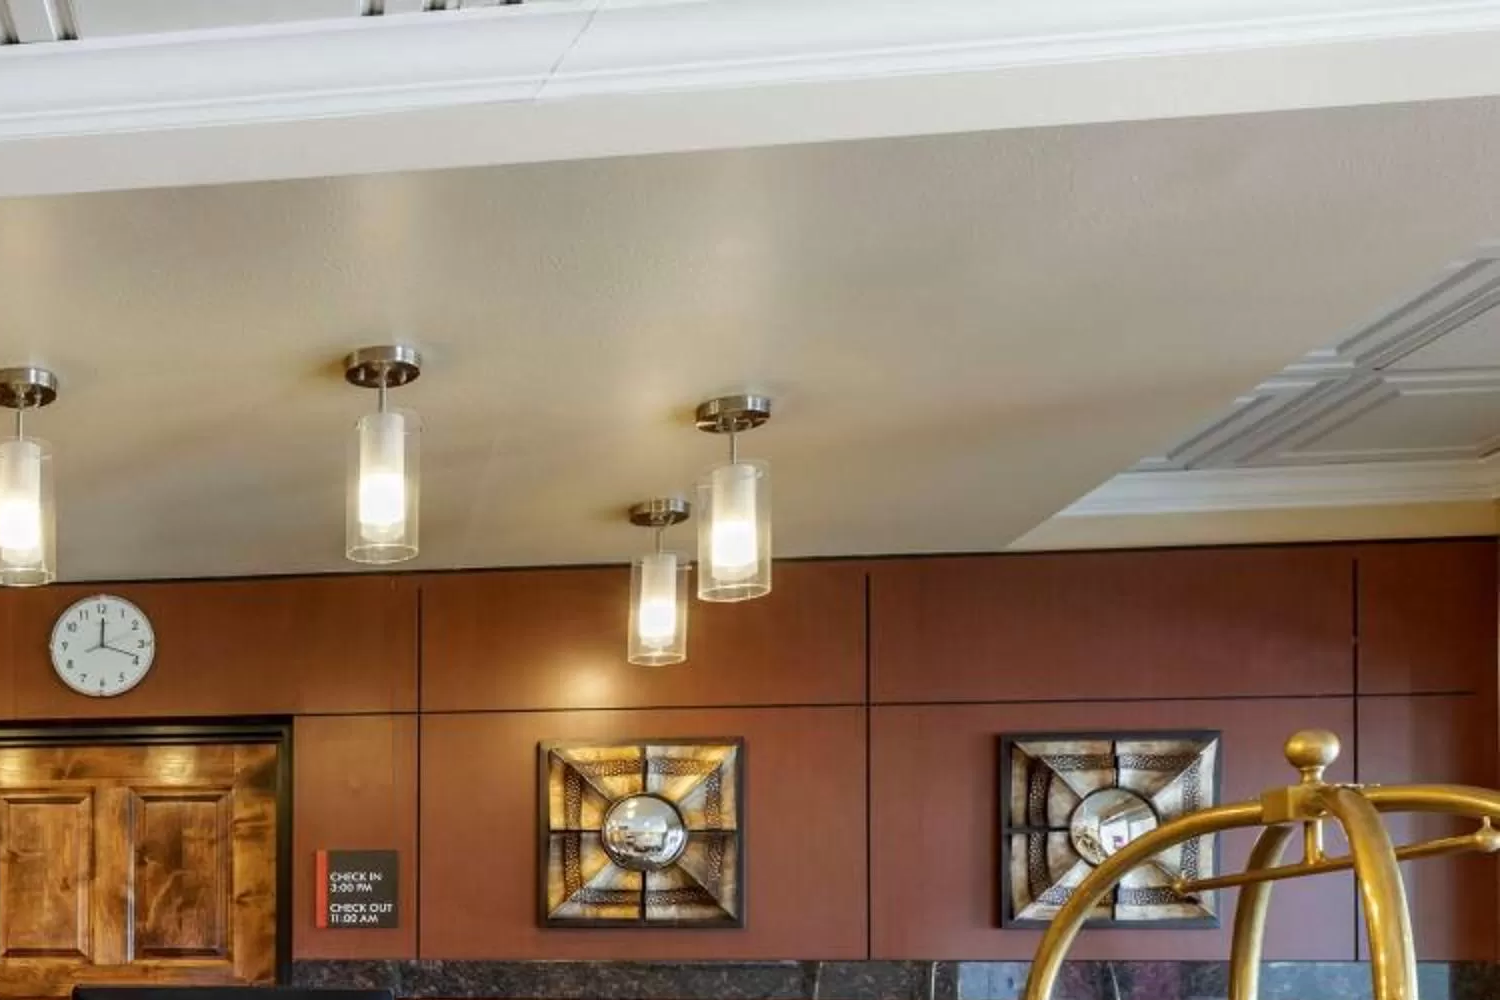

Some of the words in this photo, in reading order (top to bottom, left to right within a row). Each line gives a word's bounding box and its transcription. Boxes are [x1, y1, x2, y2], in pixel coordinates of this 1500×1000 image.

[79, 609, 89, 620] 11
[329, 871, 367, 881] CHECK
[369, 871, 383, 881] IN
[356, 883, 372, 893] PM
[329, 903, 367, 913] CHECK
[369, 903, 393, 913] OUT
[359, 914, 379, 923] AM
